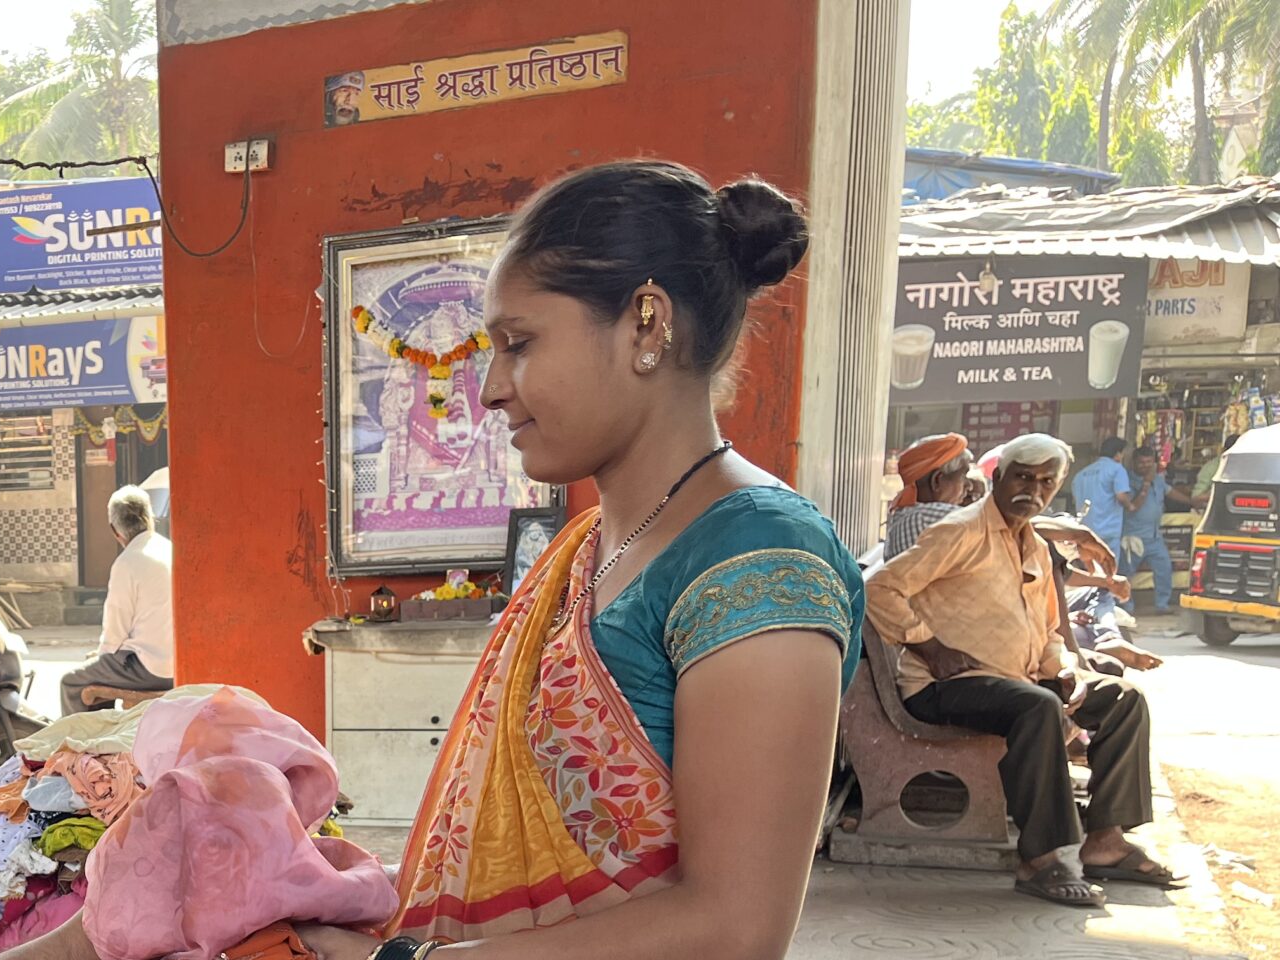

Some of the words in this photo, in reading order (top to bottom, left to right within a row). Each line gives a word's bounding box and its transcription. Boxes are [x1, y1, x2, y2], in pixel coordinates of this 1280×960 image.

[370, 65, 424, 110] साई
[435, 65, 499, 100] श्रद्धा
[506, 45, 624, 87] प्रतिष्ठान
[47, 253, 82, 265] DIGITAL
[84, 250, 129, 262] PRINTING
[130, 248, 162, 259] SOLUT
[1149, 257, 1225, 288] AJI
[1011, 273, 1125, 306] महाराष्ट्र
[1155, 298, 1196, 316] PARTS
[943, 311, 992, 331] मिल्क
[996, 307, 1042, 329] आणि
[1045, 310, 1080, 328] चहा
[933, 341, 983, 359] NAGORI
[986, 336, 1084, 356] MAHARASHTRA
[957, 368, 999, 384] MILK
[1002, 368, 1017, 382] &
[1021, 366, 1053, 381] TEA
